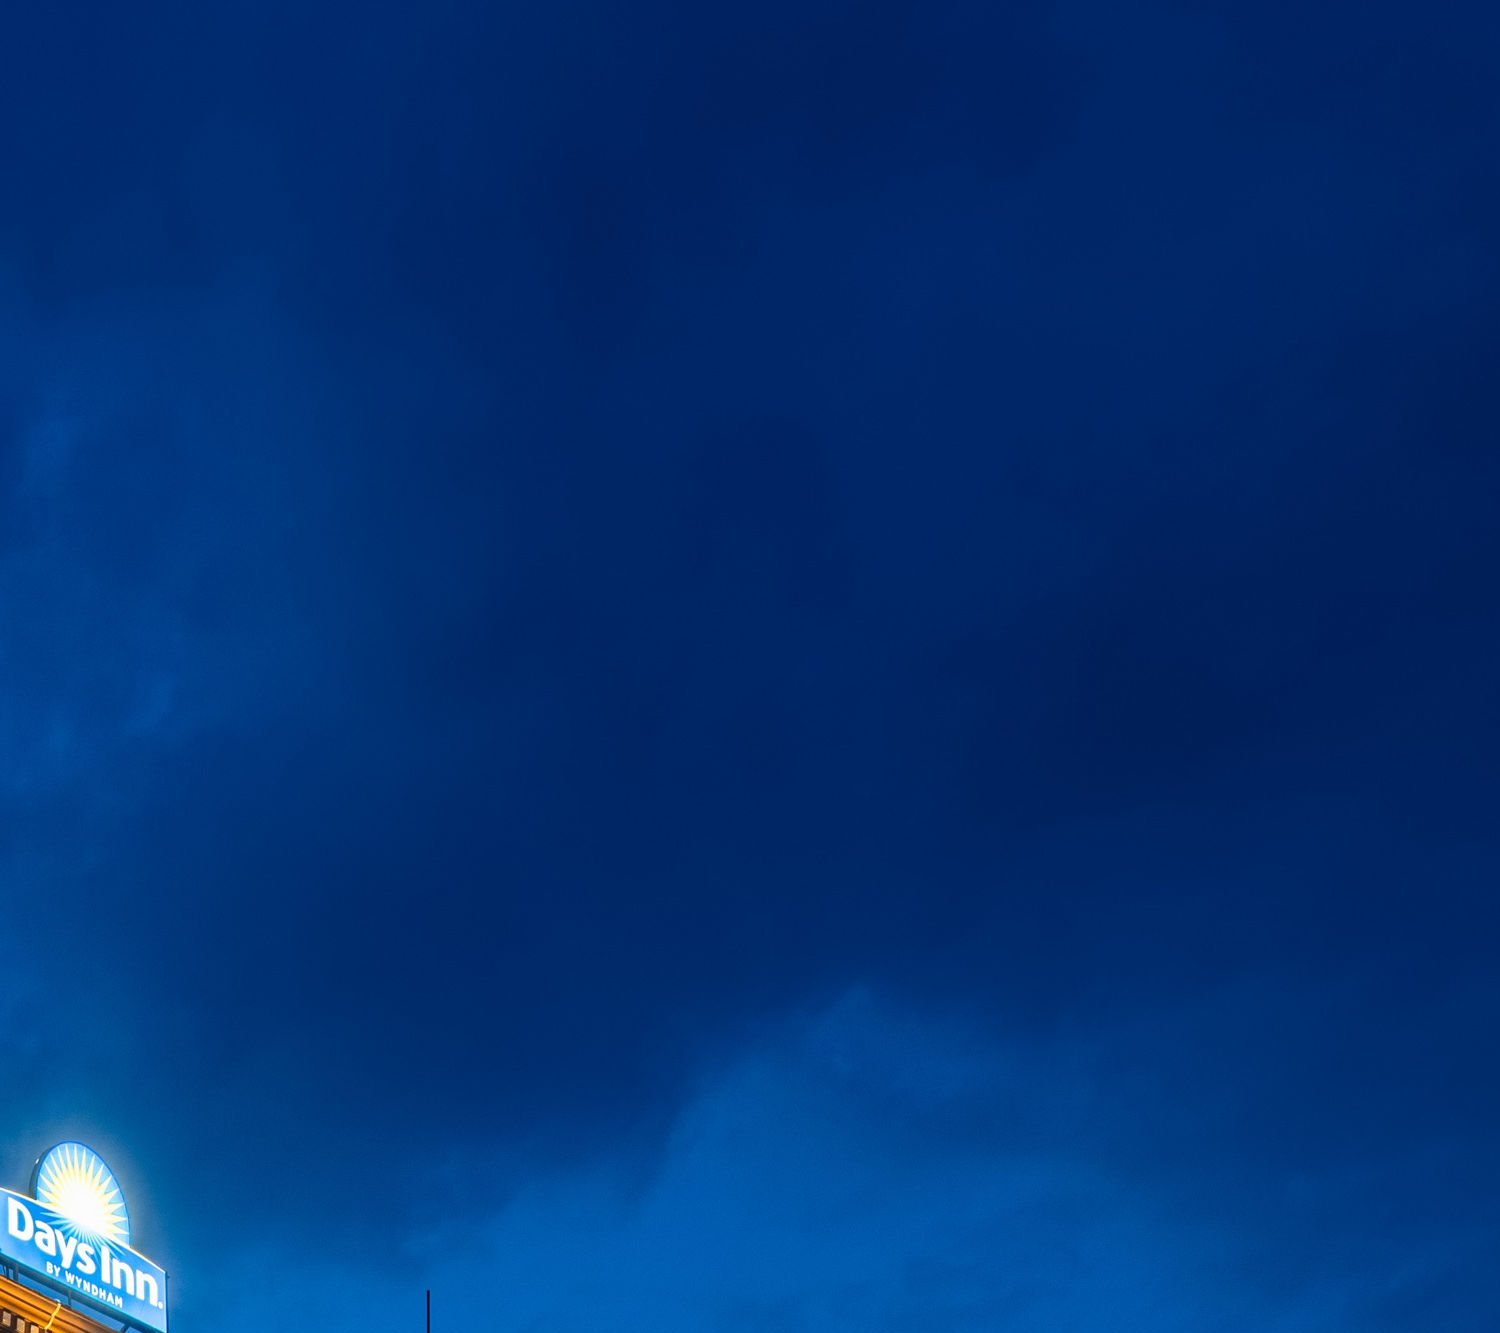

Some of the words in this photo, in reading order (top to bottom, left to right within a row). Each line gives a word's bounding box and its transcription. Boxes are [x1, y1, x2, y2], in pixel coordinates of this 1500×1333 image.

[8, 1196, 96, 1275] Days
[46, 1261, 61, 1277] BY
[65, 1272, 123, 1308] WYNDHAM
